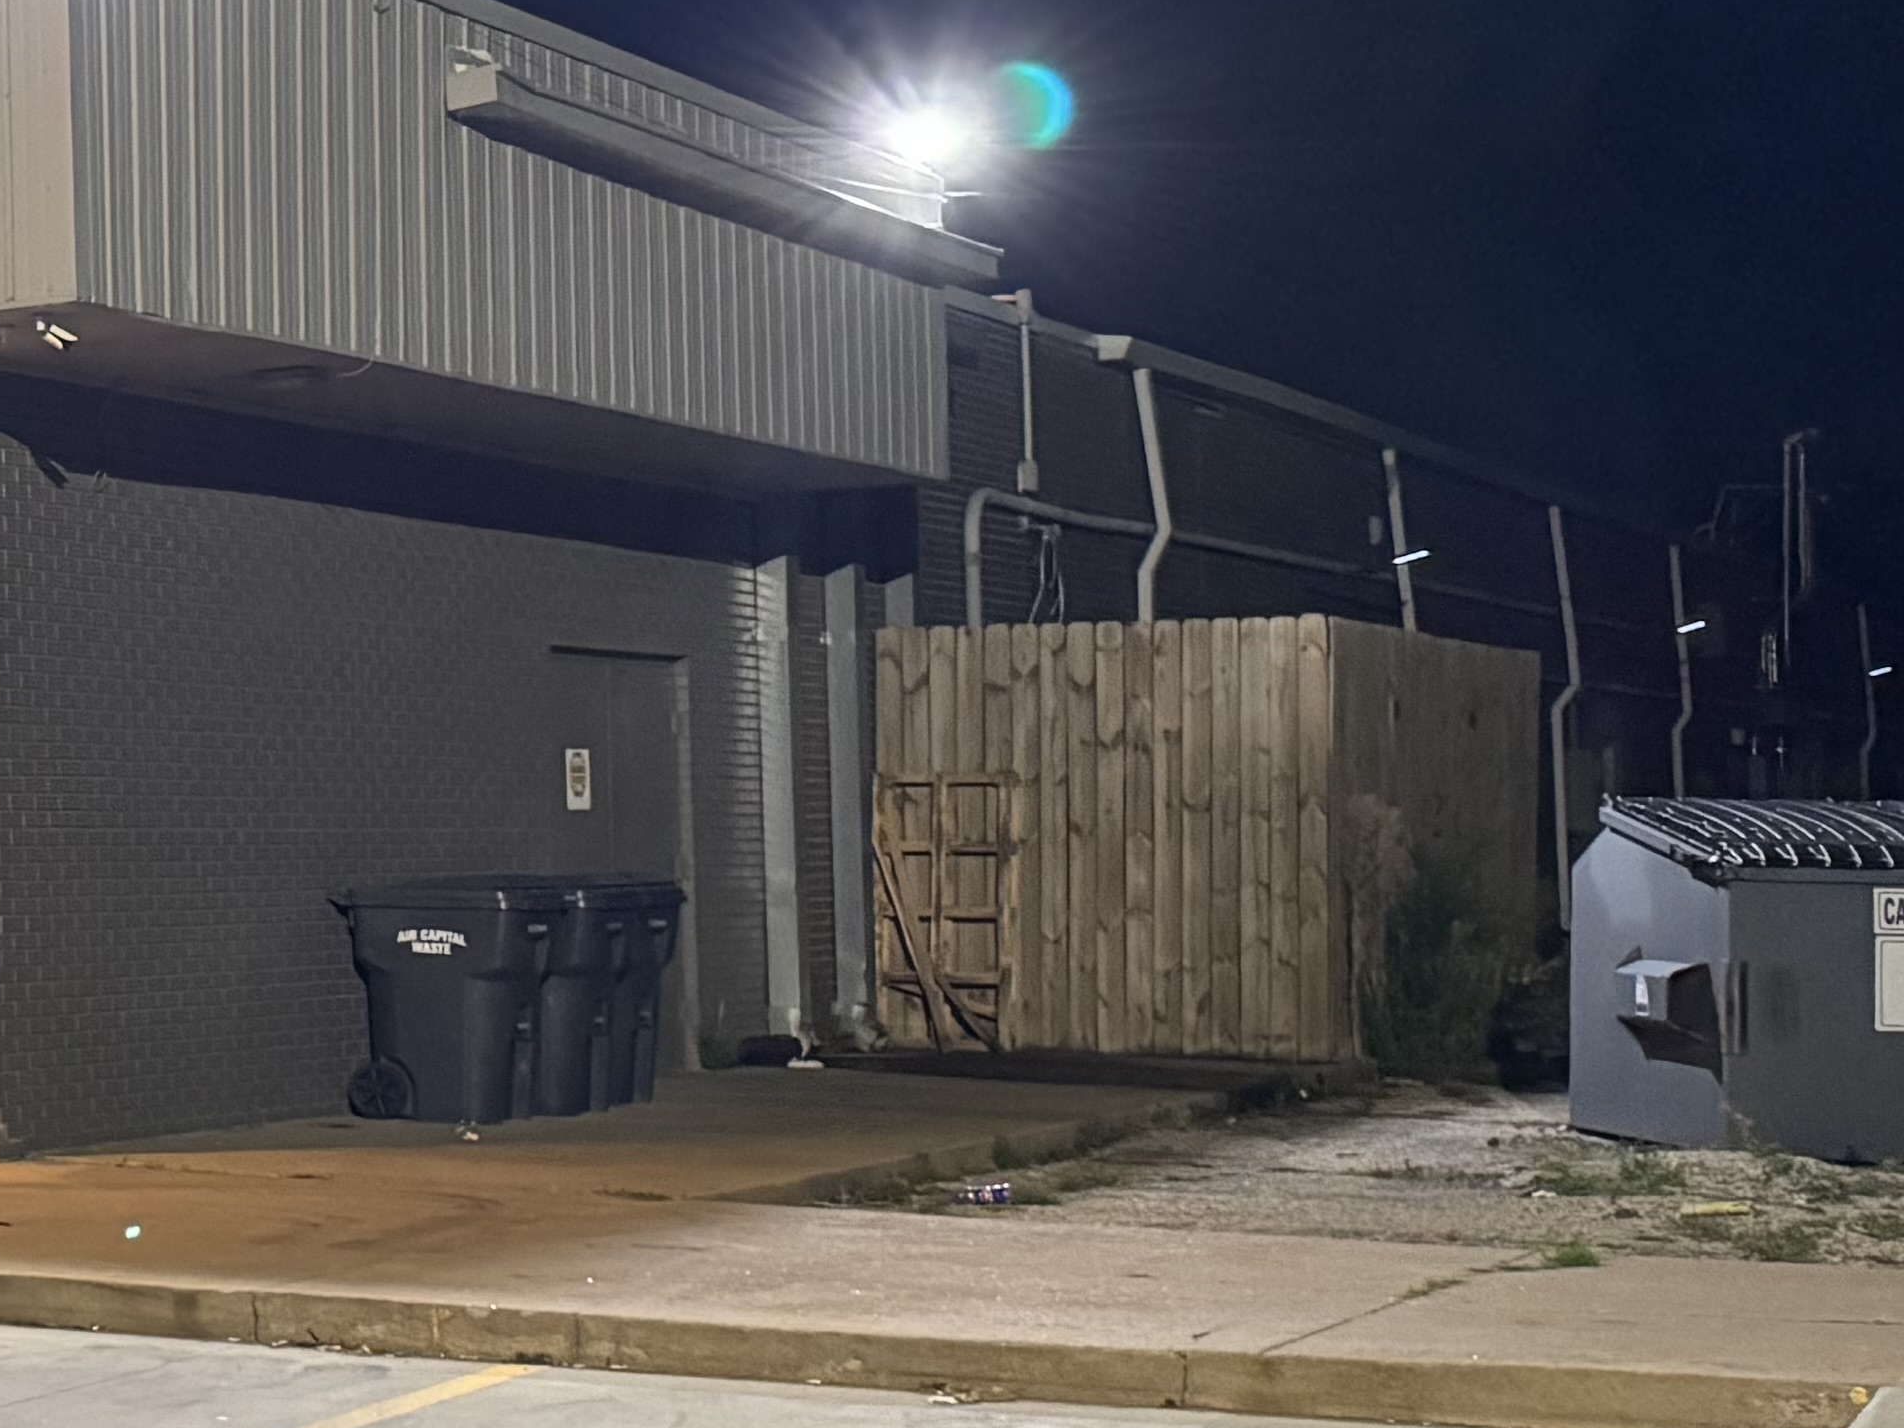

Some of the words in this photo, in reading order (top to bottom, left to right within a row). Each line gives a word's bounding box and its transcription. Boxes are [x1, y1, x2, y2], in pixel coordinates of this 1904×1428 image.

[396, 928, 418, 943] AIR
[419, 928, 468, 948] CAPITAL
[411, 941, 453, 956] WASTE
